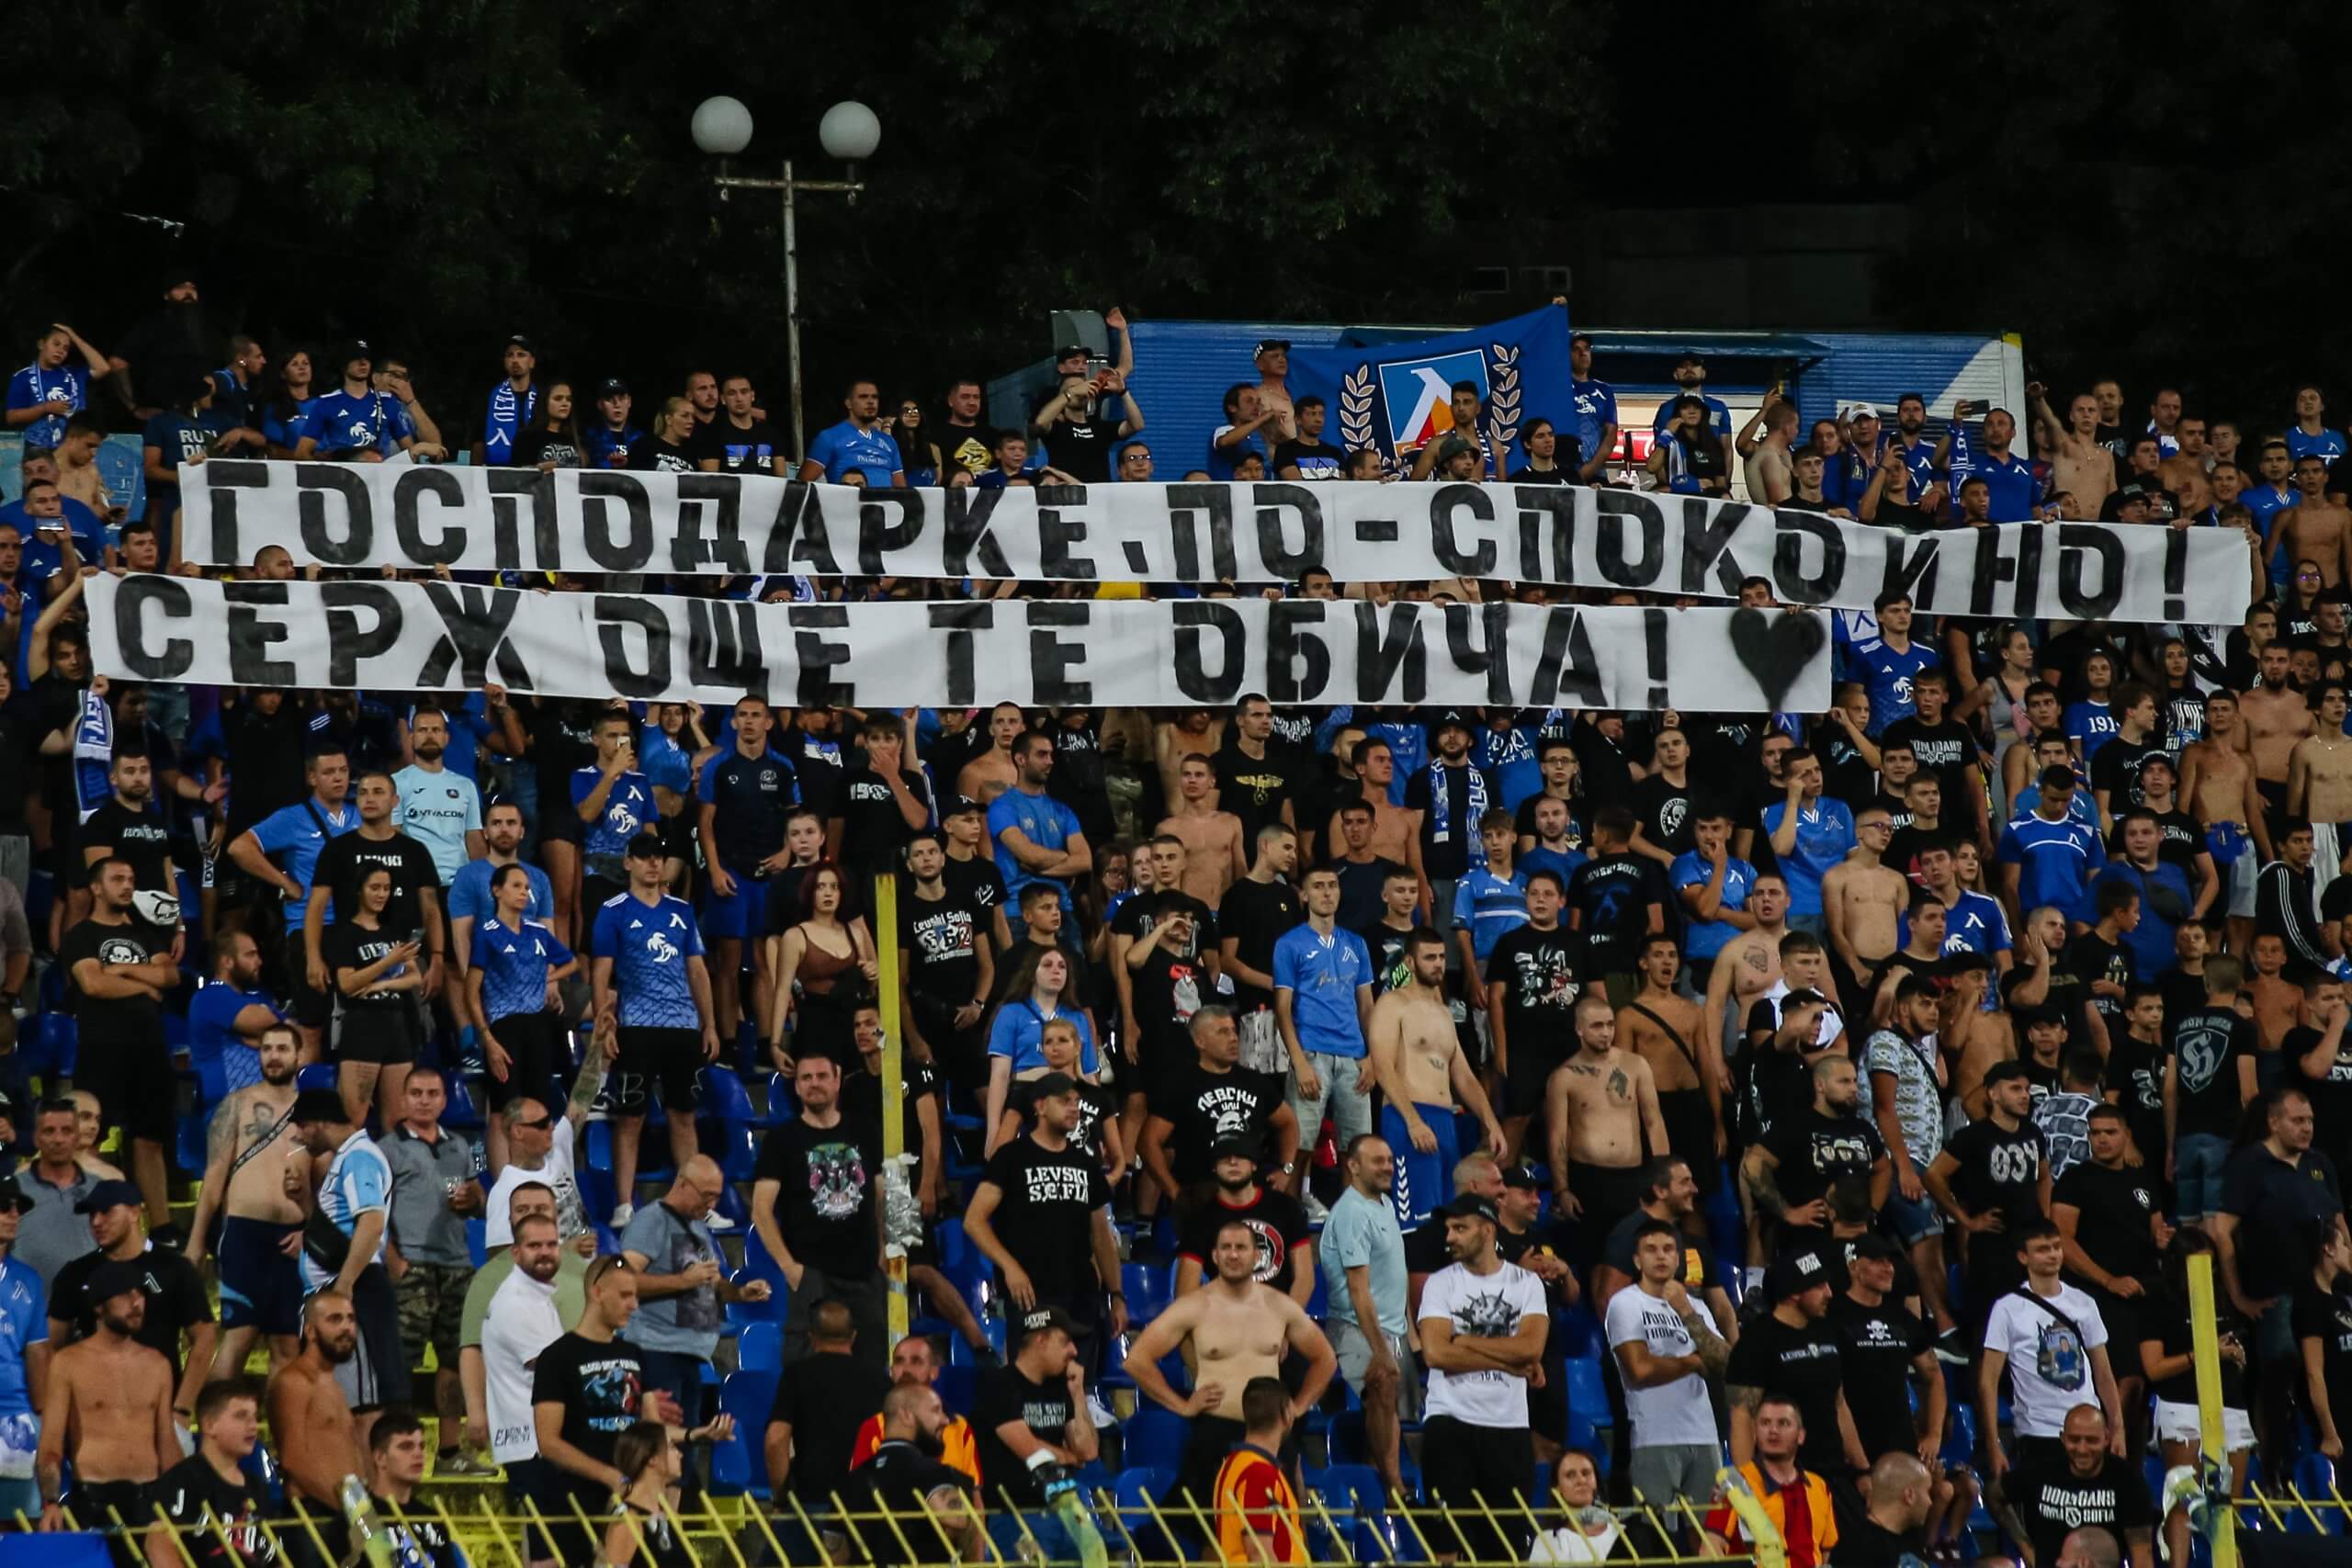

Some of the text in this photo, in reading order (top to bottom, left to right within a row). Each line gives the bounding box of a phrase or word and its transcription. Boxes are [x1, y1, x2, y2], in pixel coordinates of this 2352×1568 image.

[114, 574, 1669, 709] СЕРЖ ОЩЕ ТЕ ОБИЧА!
[1197, 1087, 1258, 1111] ЛЕВСКИ
[1024, 1166, 1089, 1186] LEVSKI
